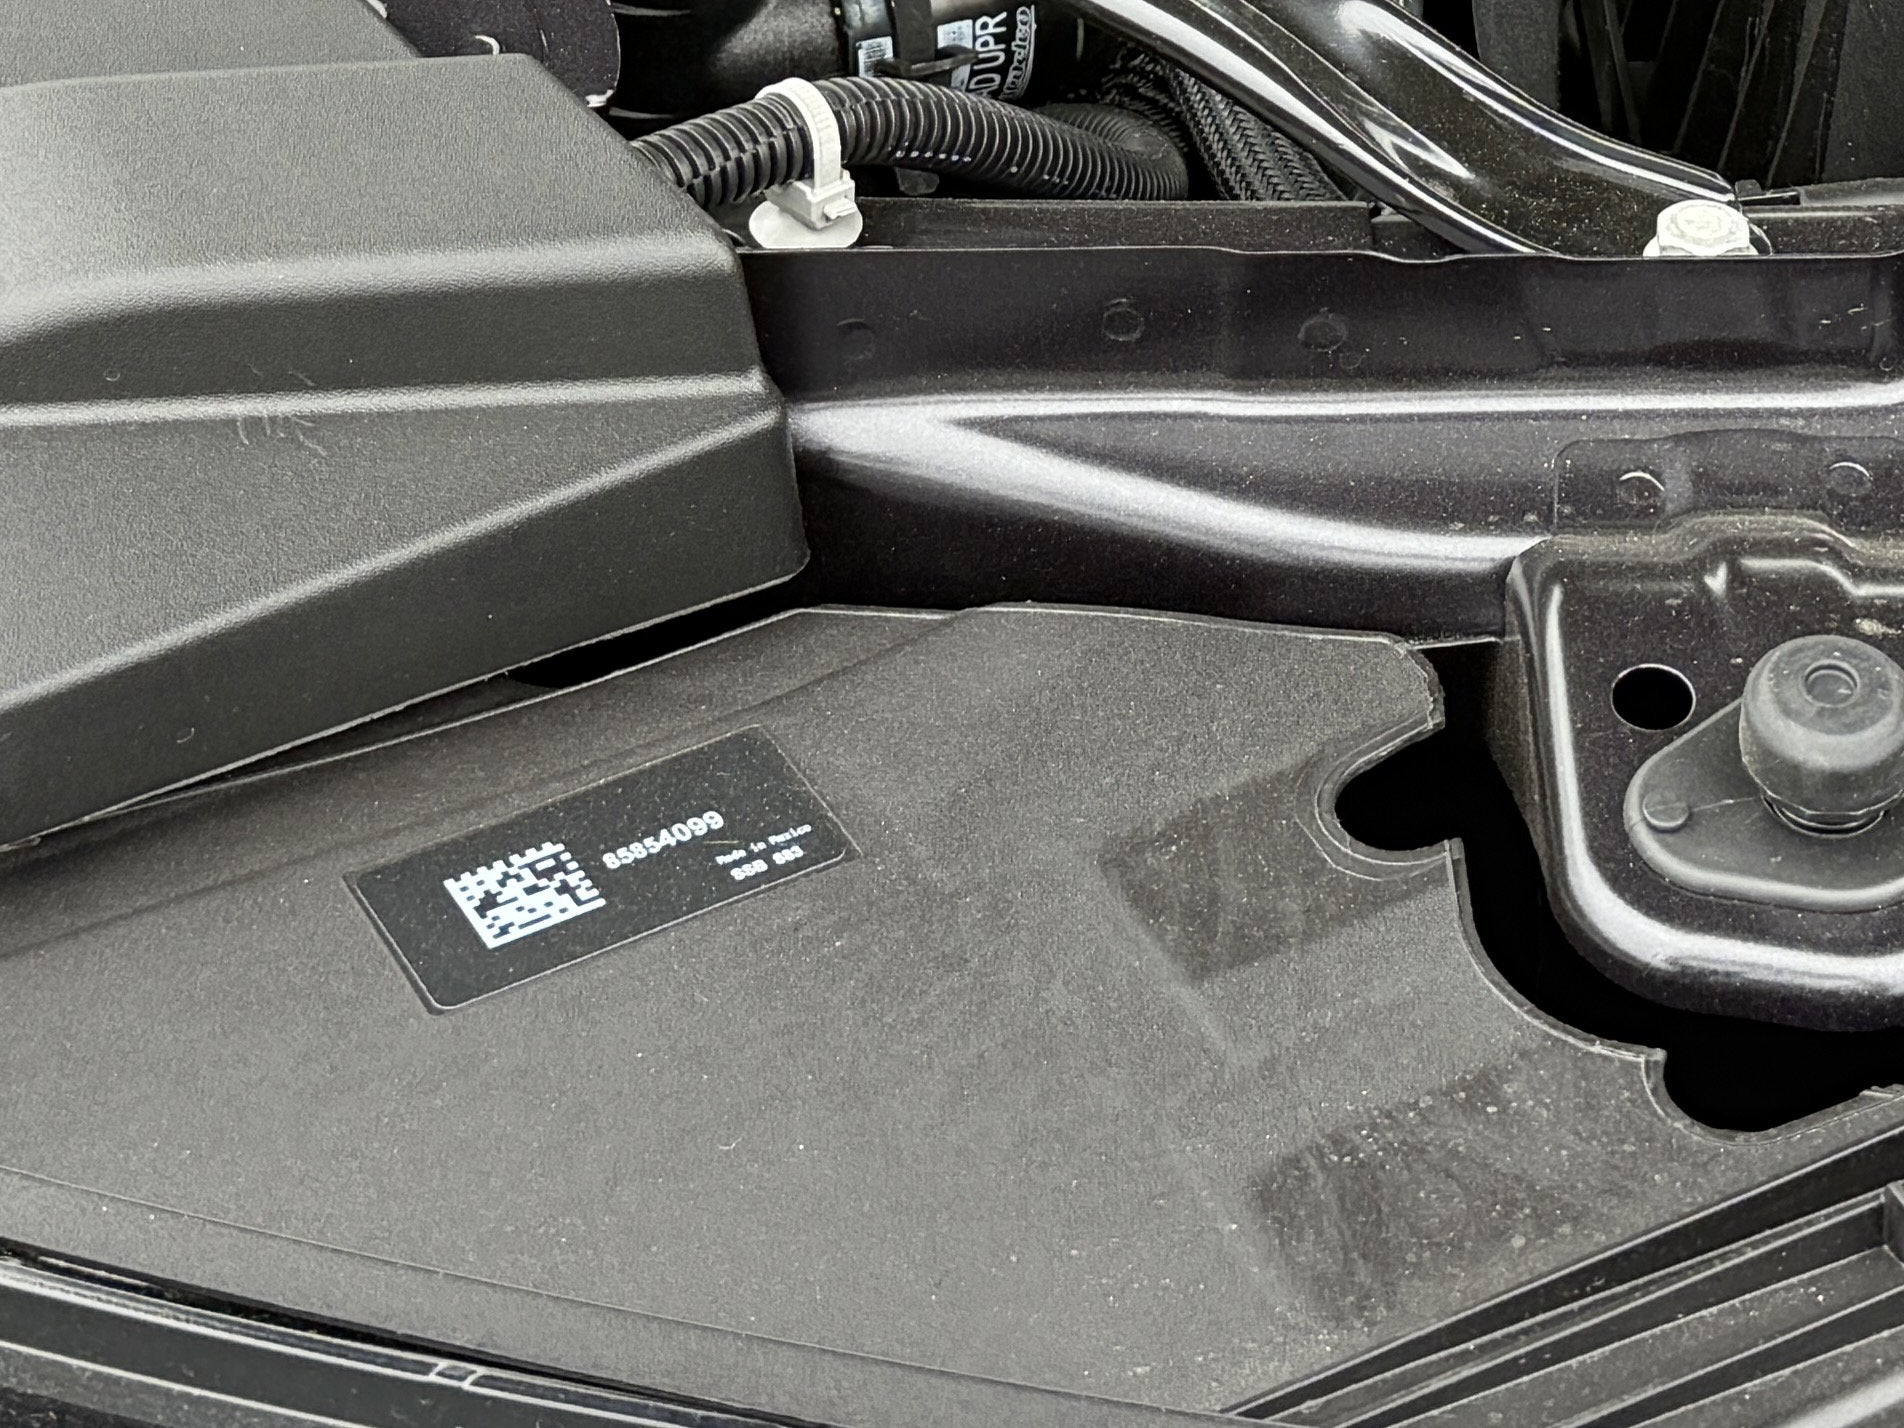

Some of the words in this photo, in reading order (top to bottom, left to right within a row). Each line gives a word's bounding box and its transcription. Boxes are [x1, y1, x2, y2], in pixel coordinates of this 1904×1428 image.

[973, 11, 1007, 70] UPR
[602, 810, 725, 871] 85854099
[716, 848, 748, 866] Made
[749, 839, 767, 854] in
[769, 823, 813, 848] Mexico
